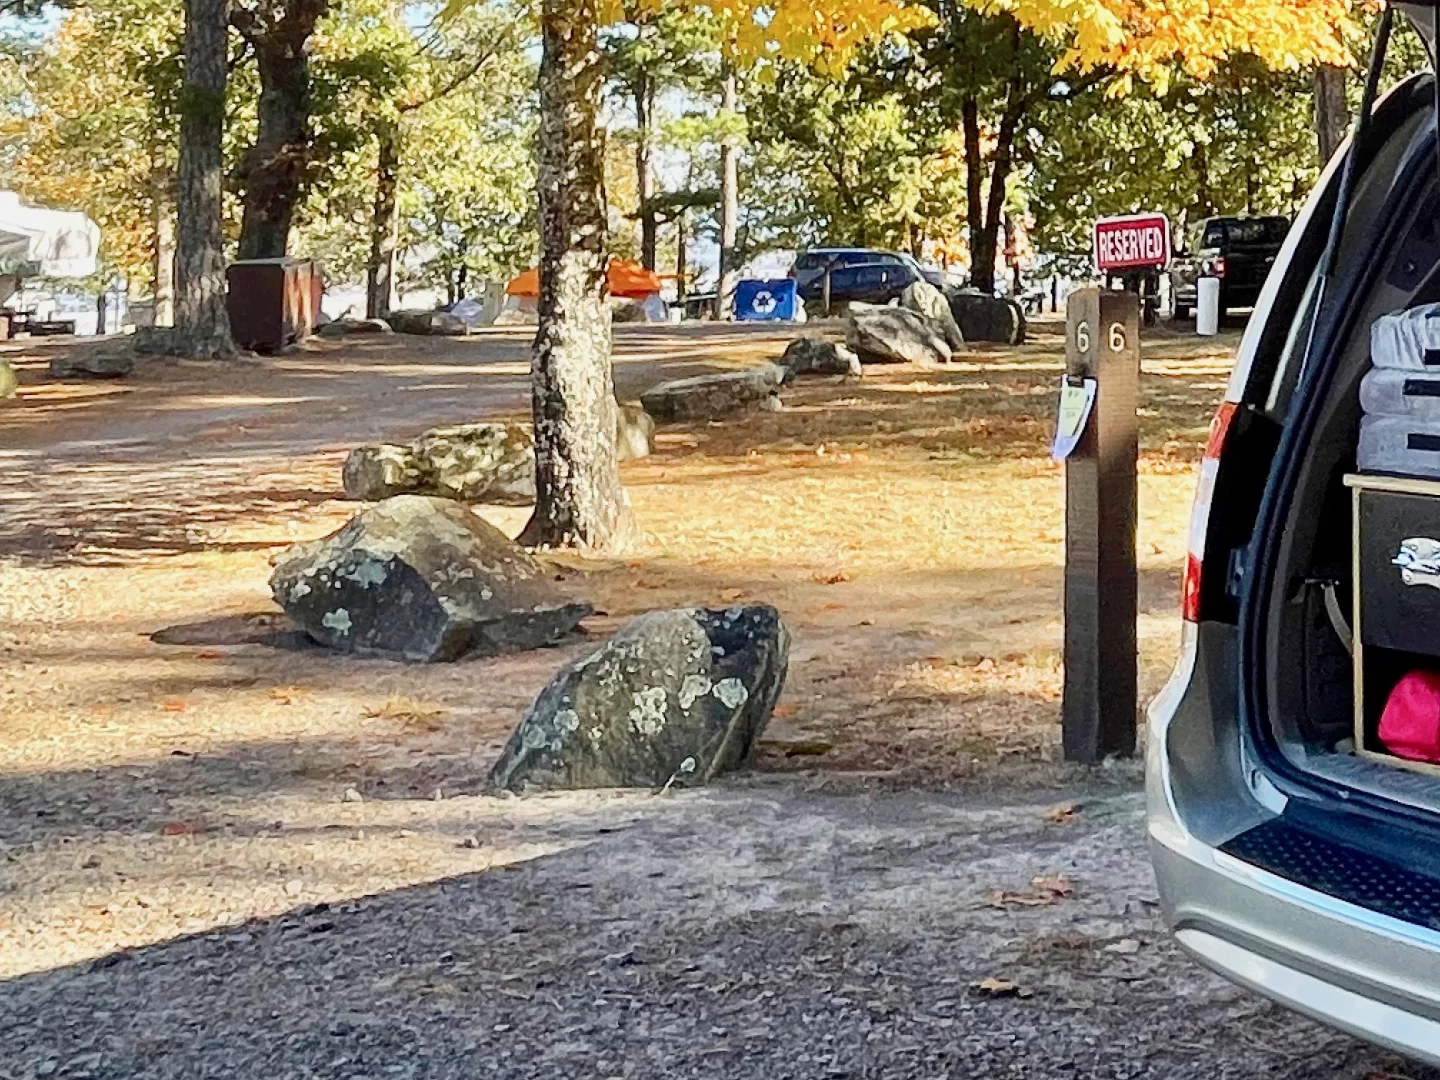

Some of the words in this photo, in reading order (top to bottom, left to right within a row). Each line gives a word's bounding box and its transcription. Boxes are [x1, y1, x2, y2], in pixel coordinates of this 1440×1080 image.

[1099, 227, 1163, 262] RESERVED
[1075, 321, 1090, 353] 6
[1108, 322, 1126, 353] 6
